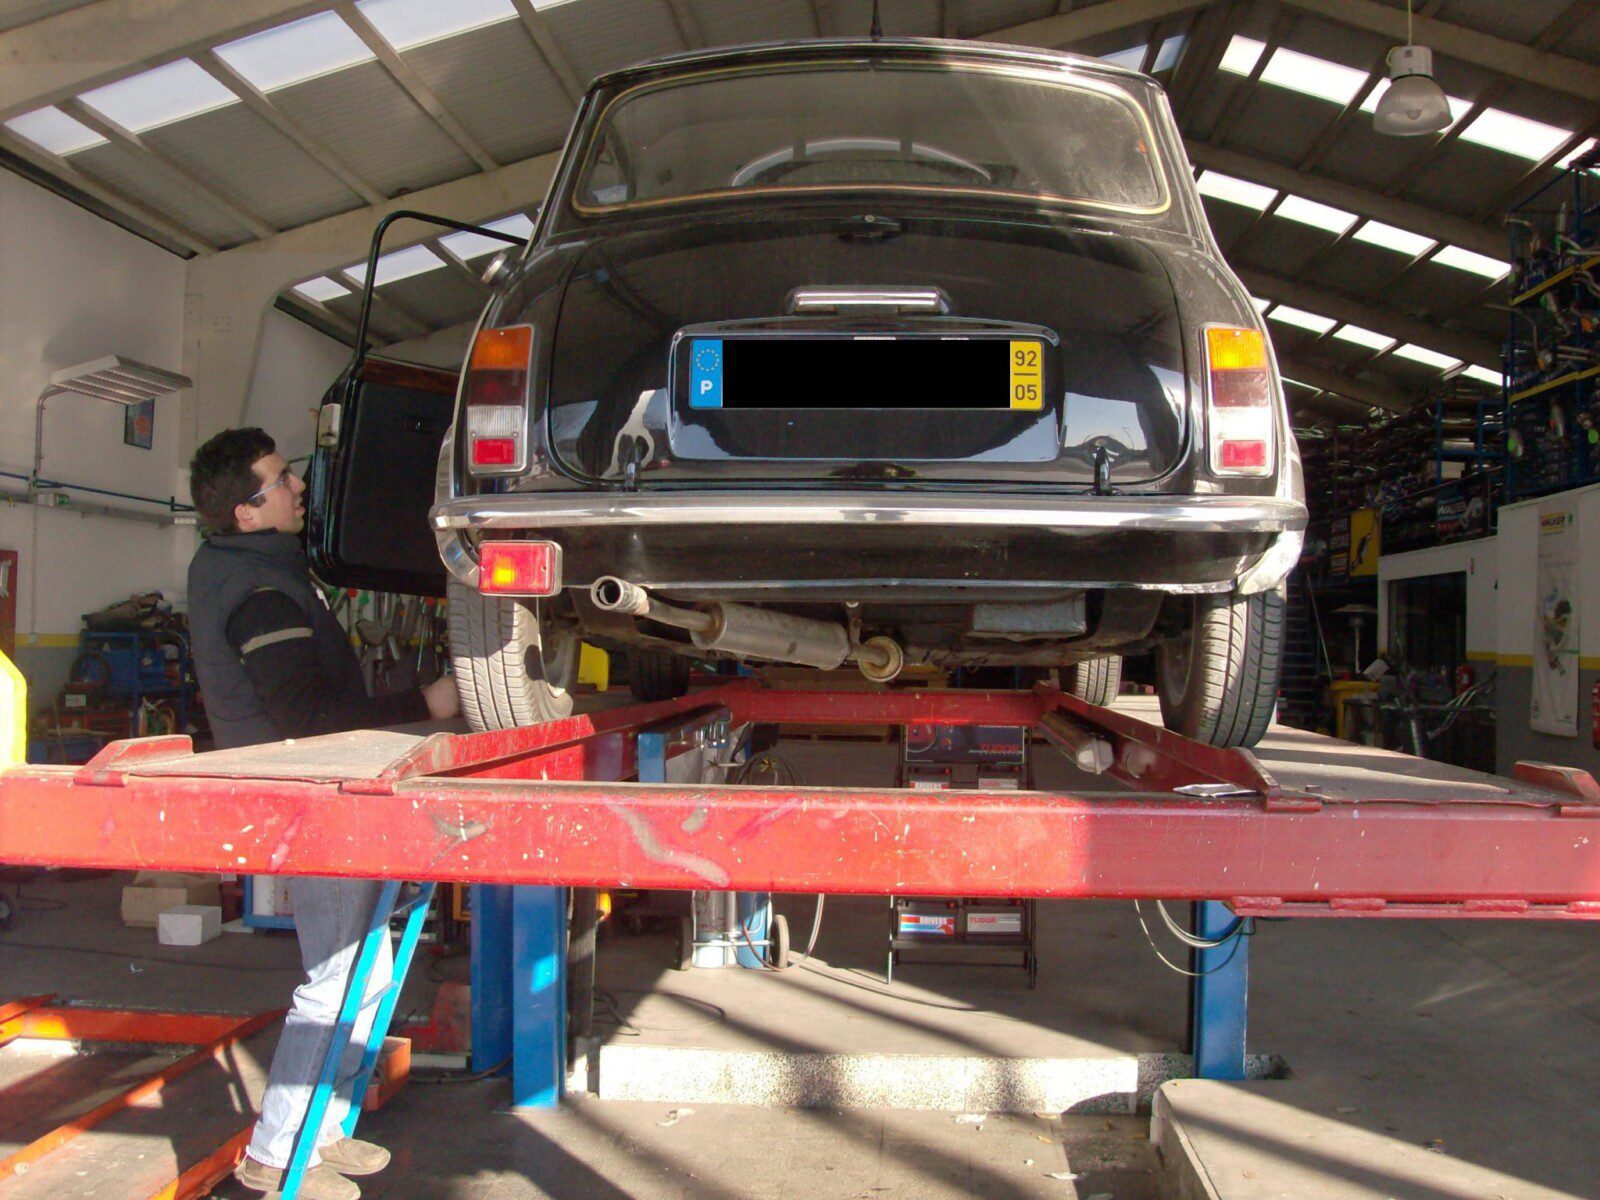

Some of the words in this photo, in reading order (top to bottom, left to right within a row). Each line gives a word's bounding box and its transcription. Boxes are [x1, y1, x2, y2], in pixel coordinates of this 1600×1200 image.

[1014, 350, 1037, 367] 92
[700, 379, 713, 395] P
[1015, 384, 1037, 401] 05
[969, 916, 997, 924] TUDOR
